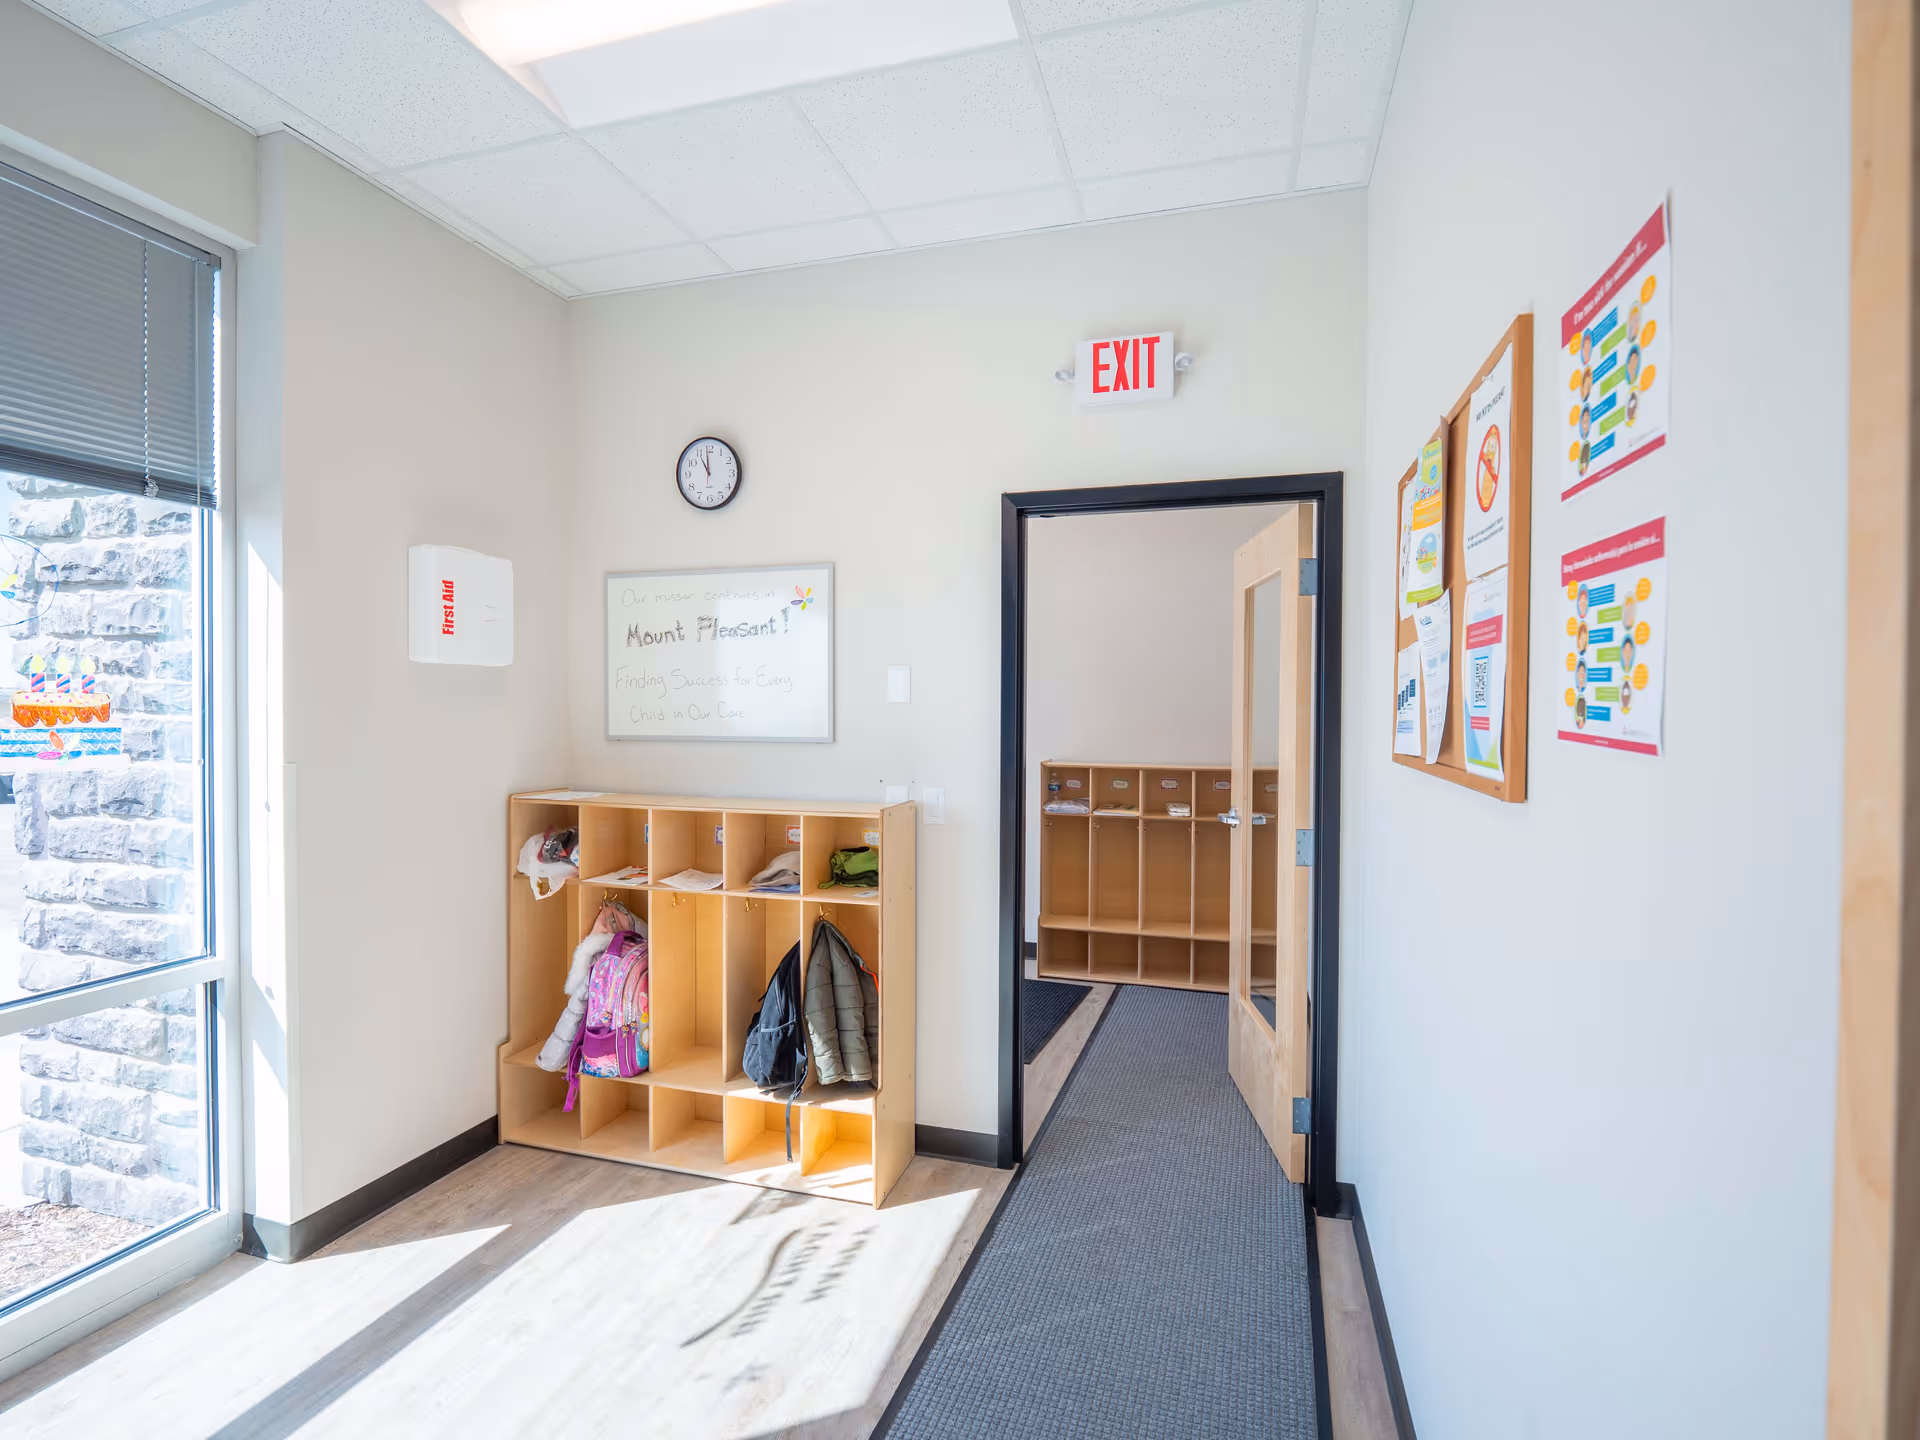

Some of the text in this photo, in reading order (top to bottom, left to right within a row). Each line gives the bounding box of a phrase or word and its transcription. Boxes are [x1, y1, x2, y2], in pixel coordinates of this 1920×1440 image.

[1092, 335, 1161, 394] EXIT
[688, 459, 698, 468] 10
[725, 456, 732, 465] 2
[684, 470, 692, 480] 9
[728, 469, 736, 478] 3
[688, 482, 695, 492] 8
[725, 482, 731, 491] 4
[696, 491, 703, 500] 7
[706, 494, 714, 503] 6
[717, 491, 724, 500] 5
[621, 588, 775, 607] Our mission continues in
[442, 579, 454, 635] First Aid
[626, 606, 790, 648] Mount Pleasant!
[615, 665, 793, 699] Finding Success for Every
[629, 704, 665, 723] Child
[673, 710, 683, 719] in
[687, 702, 710, 720] Our
